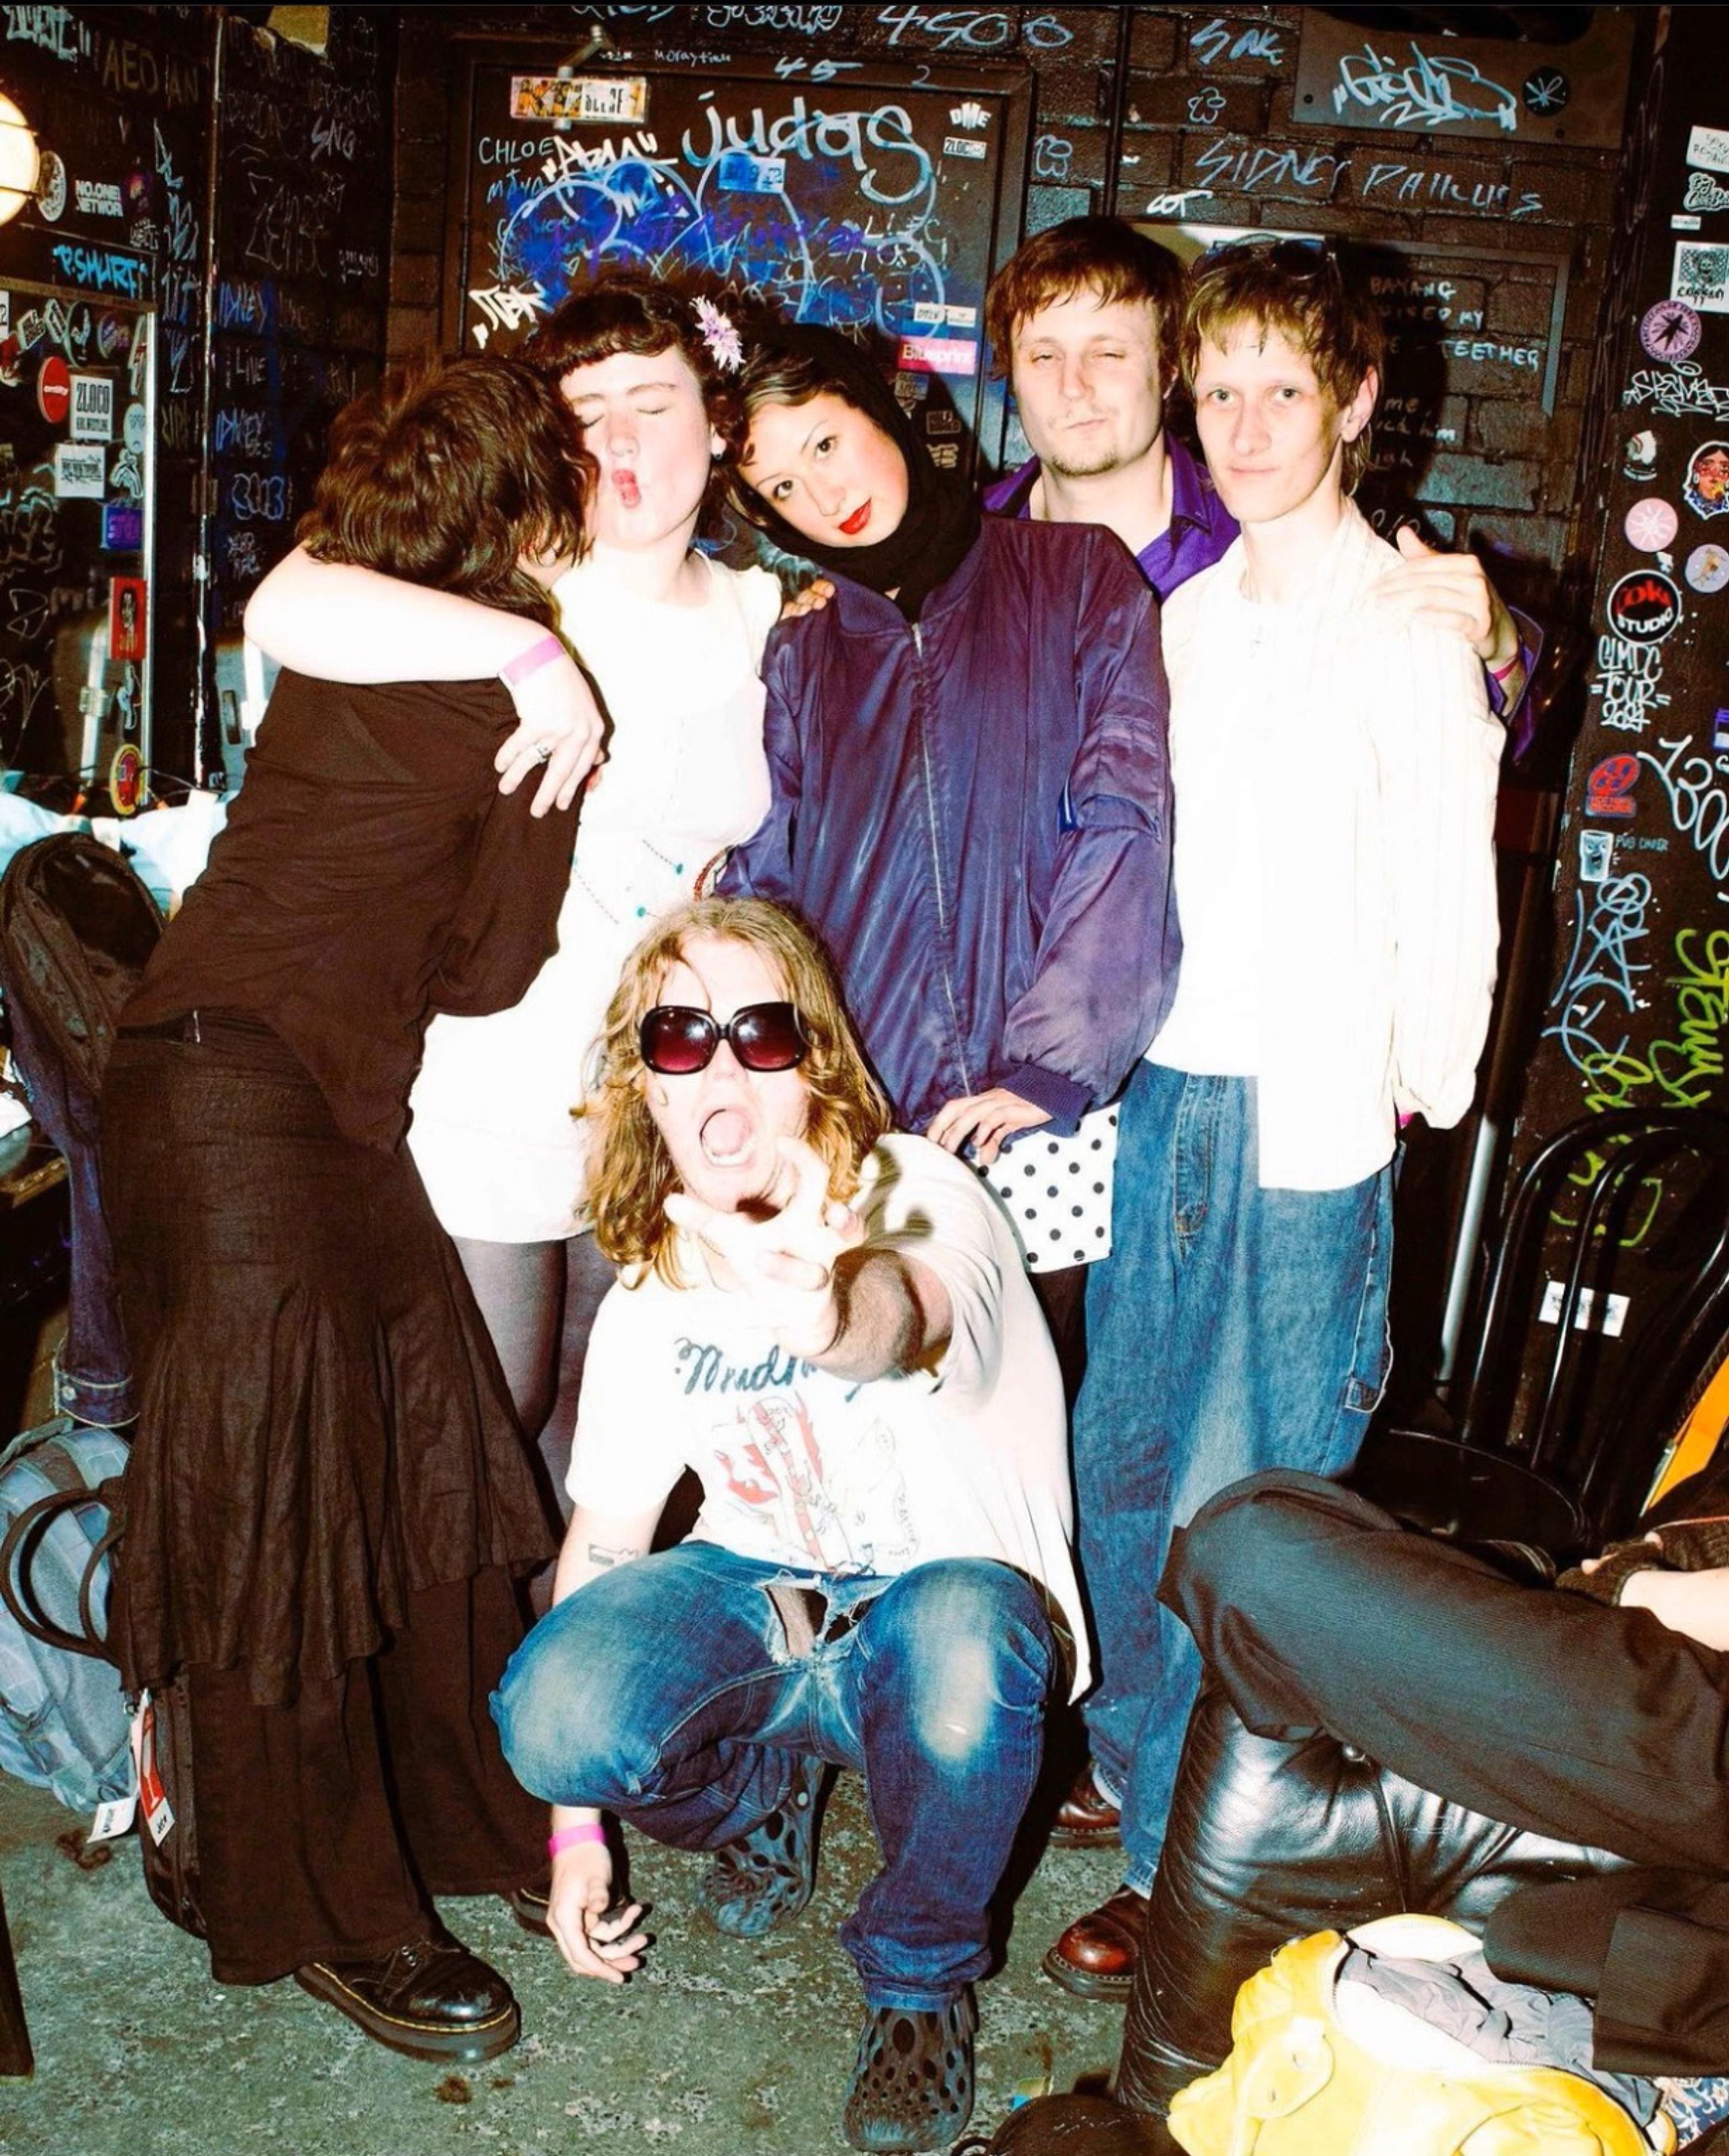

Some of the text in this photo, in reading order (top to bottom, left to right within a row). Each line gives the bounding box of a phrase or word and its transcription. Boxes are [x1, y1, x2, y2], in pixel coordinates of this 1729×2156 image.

[479, 136, 554, 165] CHLOE
[682, 91, 930, 204] judas
[1459, 310, 1484, 330] MY
[1617, 606, 1673, 634] STUDIO
